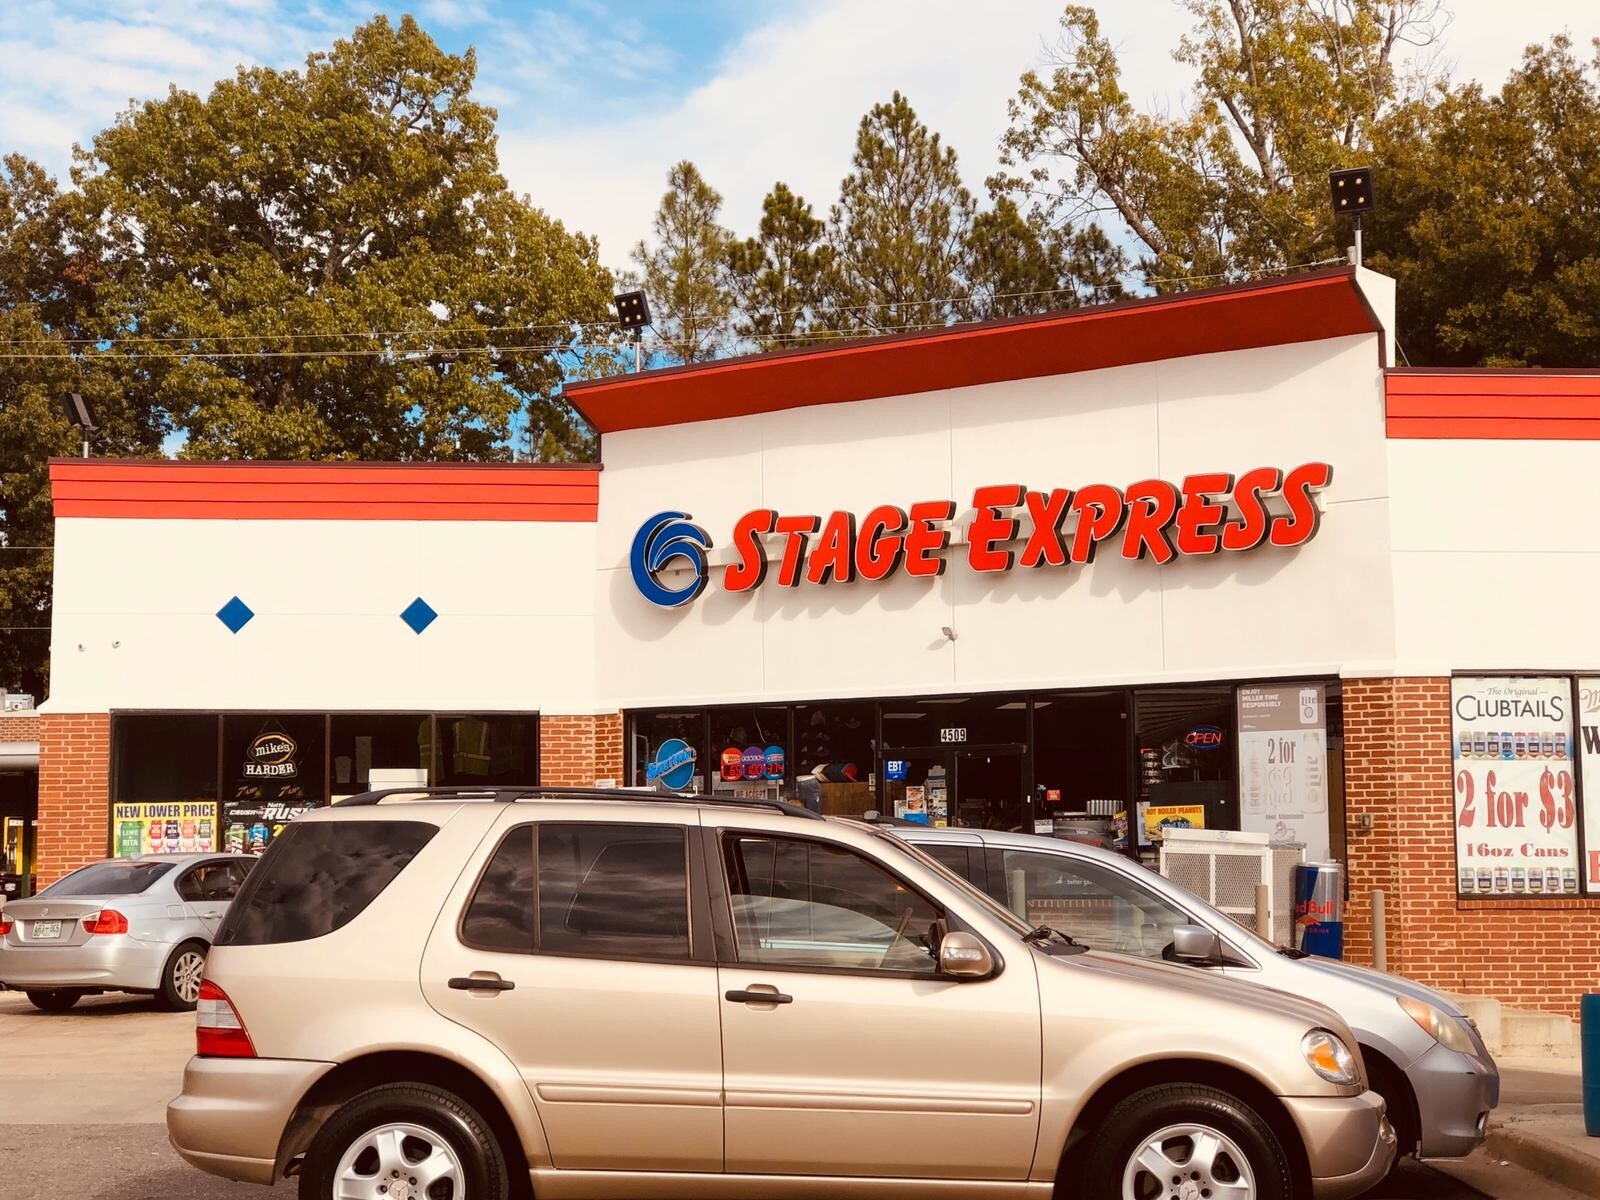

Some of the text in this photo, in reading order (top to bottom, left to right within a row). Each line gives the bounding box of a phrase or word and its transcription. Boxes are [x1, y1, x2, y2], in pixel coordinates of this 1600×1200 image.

[722, 462, 1333, 592] STAGE EXPRESS
[1488, 687, 1538, 697] The Original
[1456, 695, 1564, 722] CLUBTAILS
[941, 729, 966, 741] 4509
[1186, 732, 1221, 744] OPEN
[255, 742, 290, 757] mike's
[1267, 737, 1296, 764] 2 for
[246, 762, 296, 776] HARDER
[888, 761, 903, 772] EBT
[1457, 765, 1575, 834] 2 for $3
[116, 804, 216, 818] NEW LOWER PRICE
[1178, 806, 1203, 814] PEANUTS
[122, 839, 138, 847] RITA
[1466, 843, 1569, 857] 16oz Cans
[1309, 900, 1334, 914] Bull
